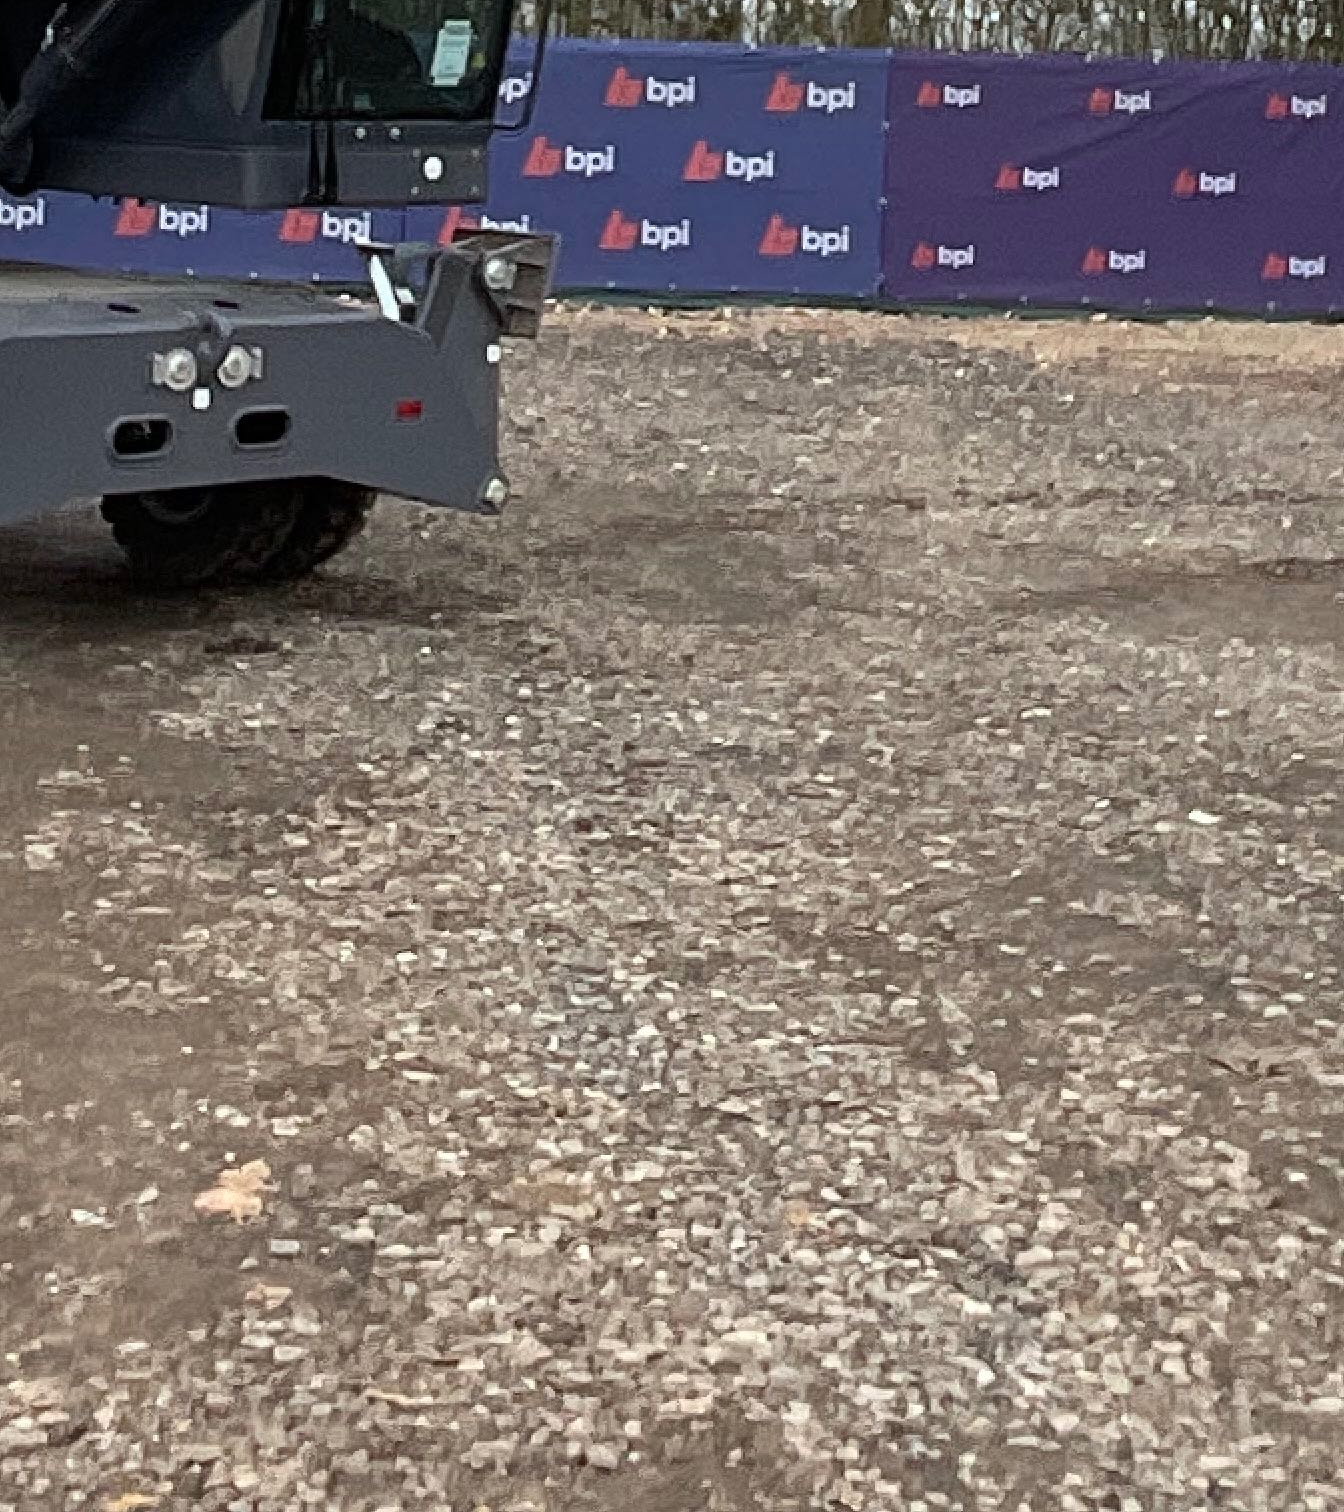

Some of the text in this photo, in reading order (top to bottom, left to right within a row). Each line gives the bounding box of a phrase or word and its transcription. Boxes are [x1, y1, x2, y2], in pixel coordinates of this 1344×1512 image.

[497, 72, 534, 104] pi
[646, 76, 696, 108] bpi
[806, 82, 856, 114] bpi
[944, 84, 980, 108] bpi
[1114, 90, 1151, 114] bpi
[1290, 94, 1326, 118] bpi
[564, 146, 614, 178] bpi
[726, 150, 774, 182] bpi
[1022, 166, 1060, 190] bpi
[1200, 172, 1236, 195] bpi
[158, 204, 208, 236] bpi
[321, 210, 372, 244] bpi
[641, 218, 690, 250] bpi
[802, 224, 850, 256] bpi
[938, 244, 974, 270] bpi
[1108, 250, 1146, 273] bpi
[1288, 256, 1326, 279] bpi
